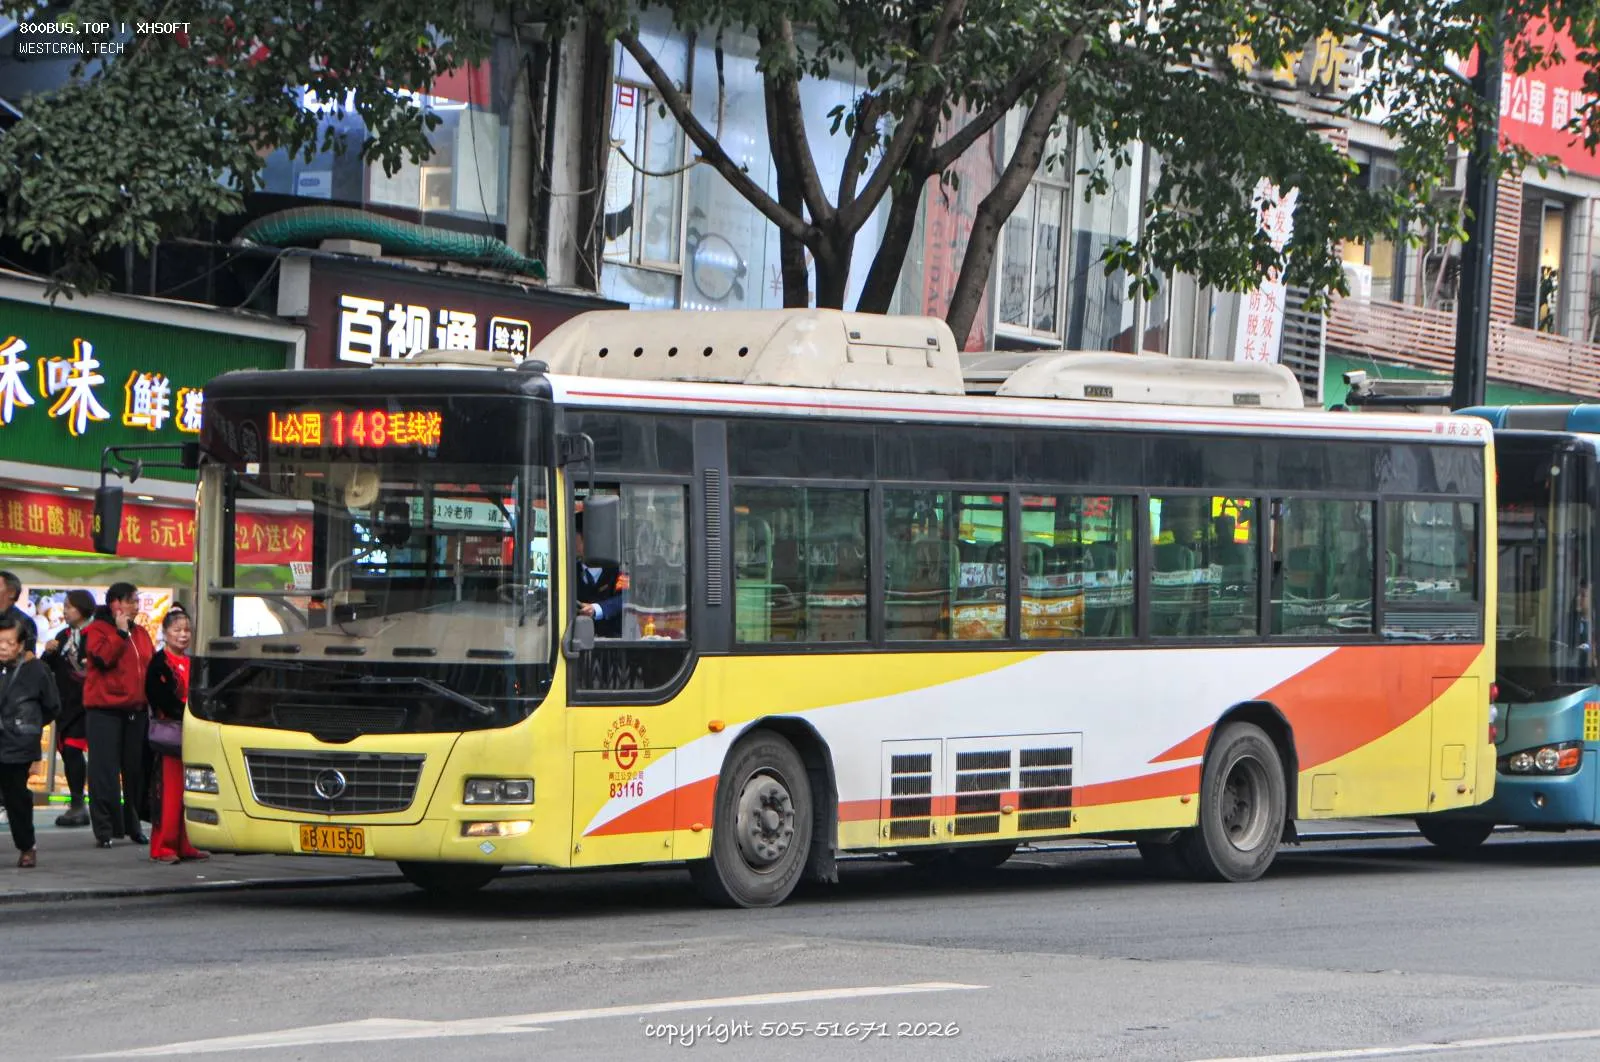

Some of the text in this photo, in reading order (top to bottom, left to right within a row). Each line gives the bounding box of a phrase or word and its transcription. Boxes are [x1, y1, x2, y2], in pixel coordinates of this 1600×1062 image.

[339, 294, 477, 365] 百视通
[494, 326, 525, 352] 验光
[332, 410, 387, 446] 148
[1435, 422, 1482, 437] 重庆公交
[609, 781, 644, 799] 83116
